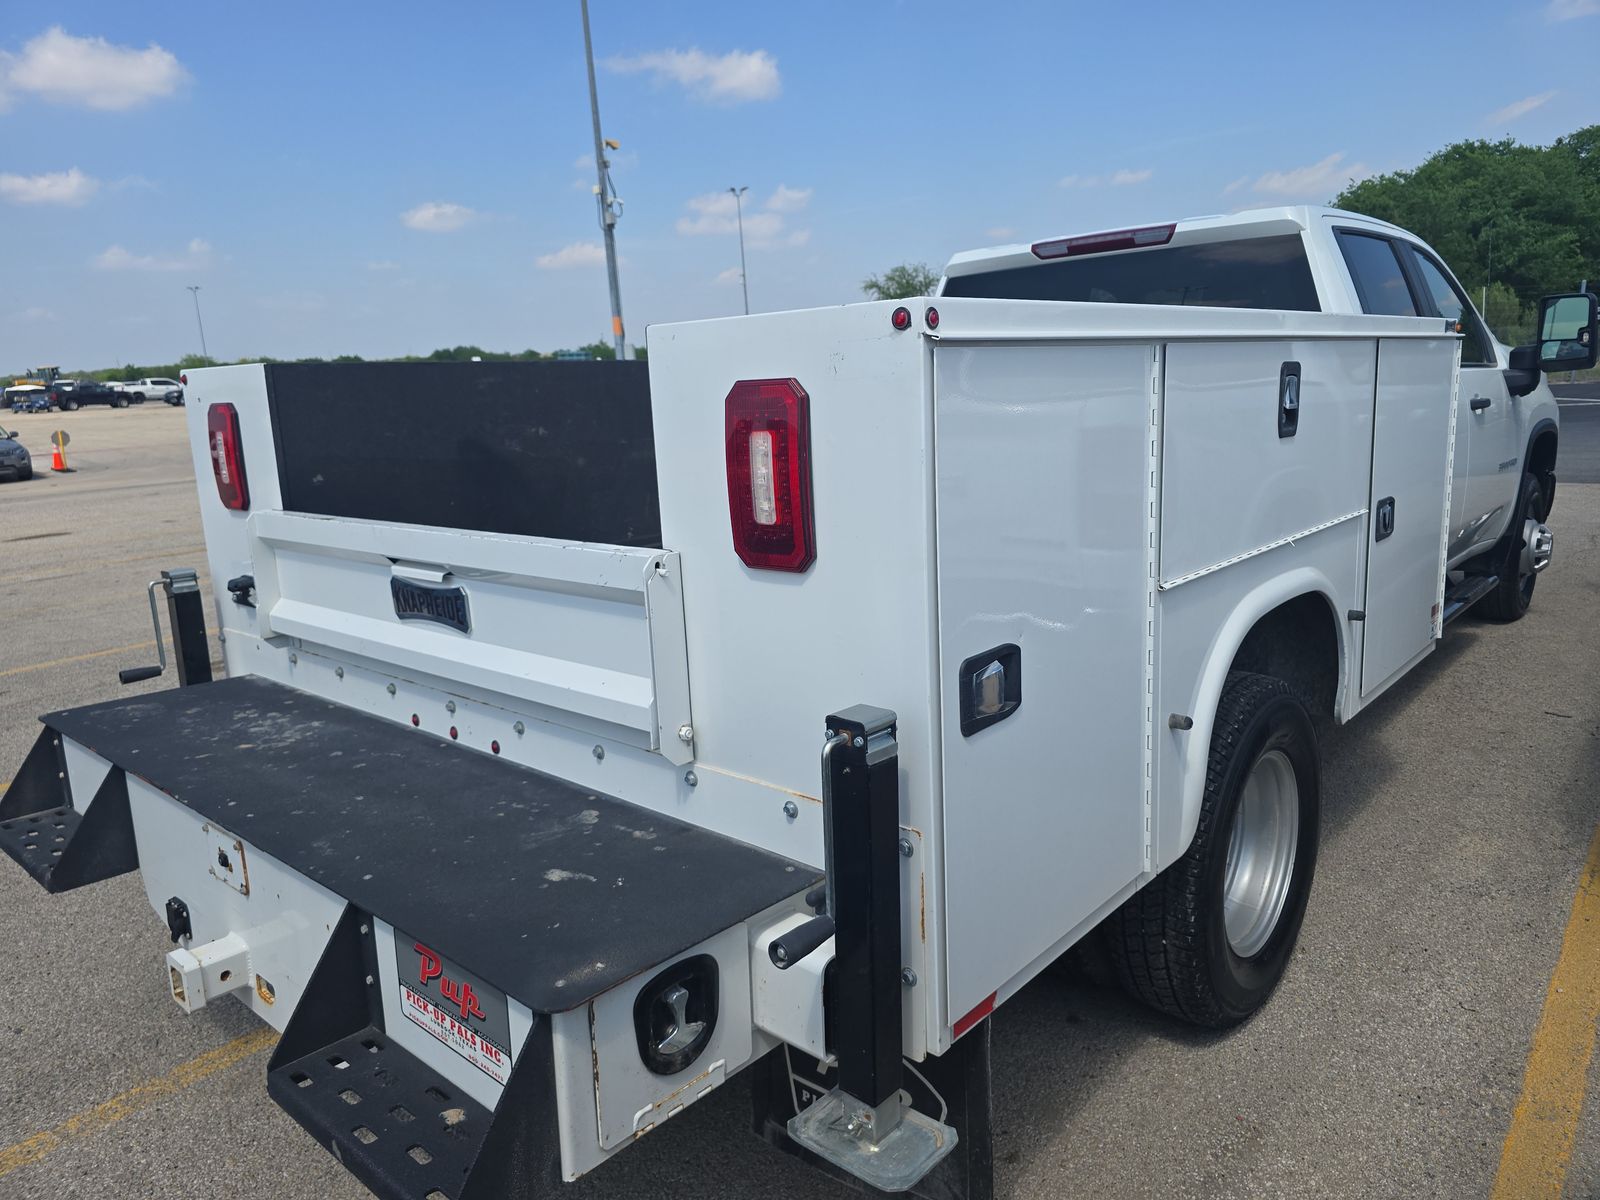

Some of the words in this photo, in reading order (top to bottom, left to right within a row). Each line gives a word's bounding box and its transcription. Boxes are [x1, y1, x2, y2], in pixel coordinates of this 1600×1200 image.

[393, 582, 465, 626] KNAPHEIDE
[406, 989, 447, 1025] PICK-UP
[449, 1018, 477, 1047] PALS
[480, 1039, 505, 1066] INC.
[458, 1036, 477, 1052] TEXAS
